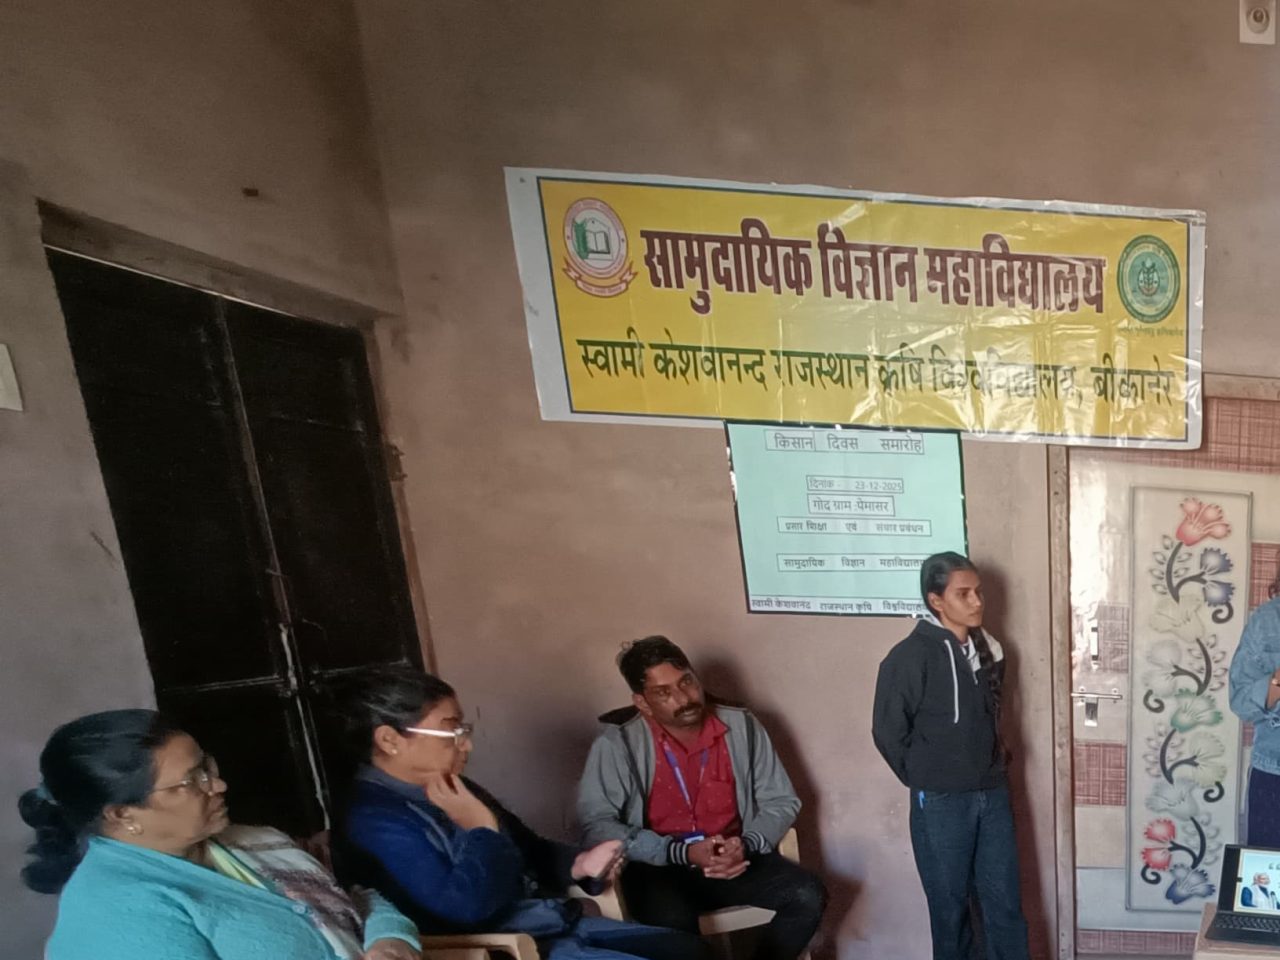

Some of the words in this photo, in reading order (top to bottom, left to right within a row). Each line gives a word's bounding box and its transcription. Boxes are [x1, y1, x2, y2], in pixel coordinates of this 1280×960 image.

[640, 218, 812, 315] सामुदायिक
[817, 223, 918, 303] विज्ञान
[576, 326, 645, 379] स्वामी
[648, 327, 769, 391] केशवानन्द
[770, 349, 869, 390] राजस्थान
[876, 341, 924, 397] कृषि
[1090, 352, 1175, 407] बीकानेर
[774, 432, 814, 450] किसान
[827, 433, 859, 451] दिवस
[880, 433, 922, 453] समारोह
[813, 496, 831, 512] गोद
[833, 499, 851, 512] ग्राम
[784, 557, 825, 570] सामुदायिक
[841, 556, 865, 568] विज्ञान
